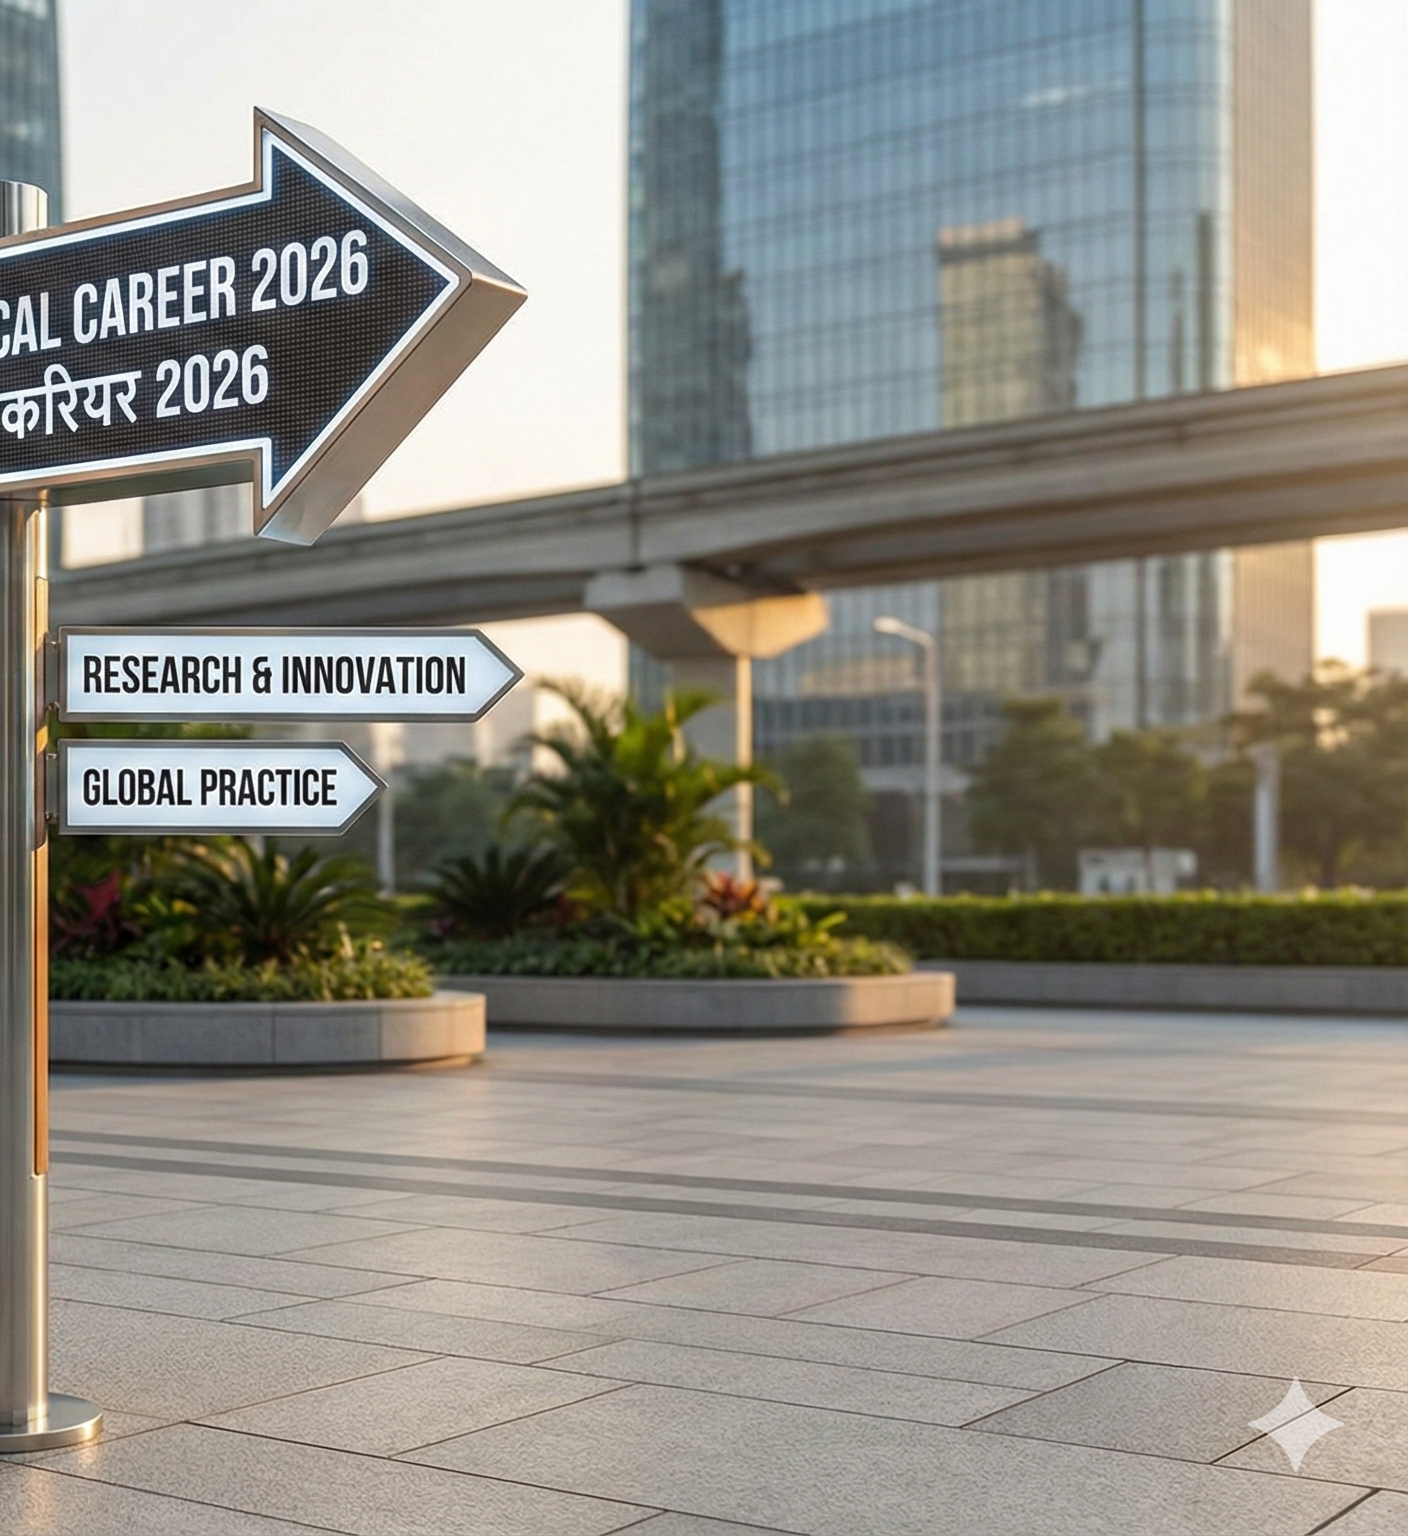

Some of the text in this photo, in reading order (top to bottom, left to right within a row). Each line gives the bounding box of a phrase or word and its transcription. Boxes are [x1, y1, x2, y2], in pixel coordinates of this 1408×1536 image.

[73, 255, 237, 344] CAREER
[251, 229, 369, 312] 2026
[155, 344, 269, 419] 2026
[83, 655, 466, 695] RESEARCH & INNOVATION
[83, 768, 338, 806] GLOBAL PRACTICE
